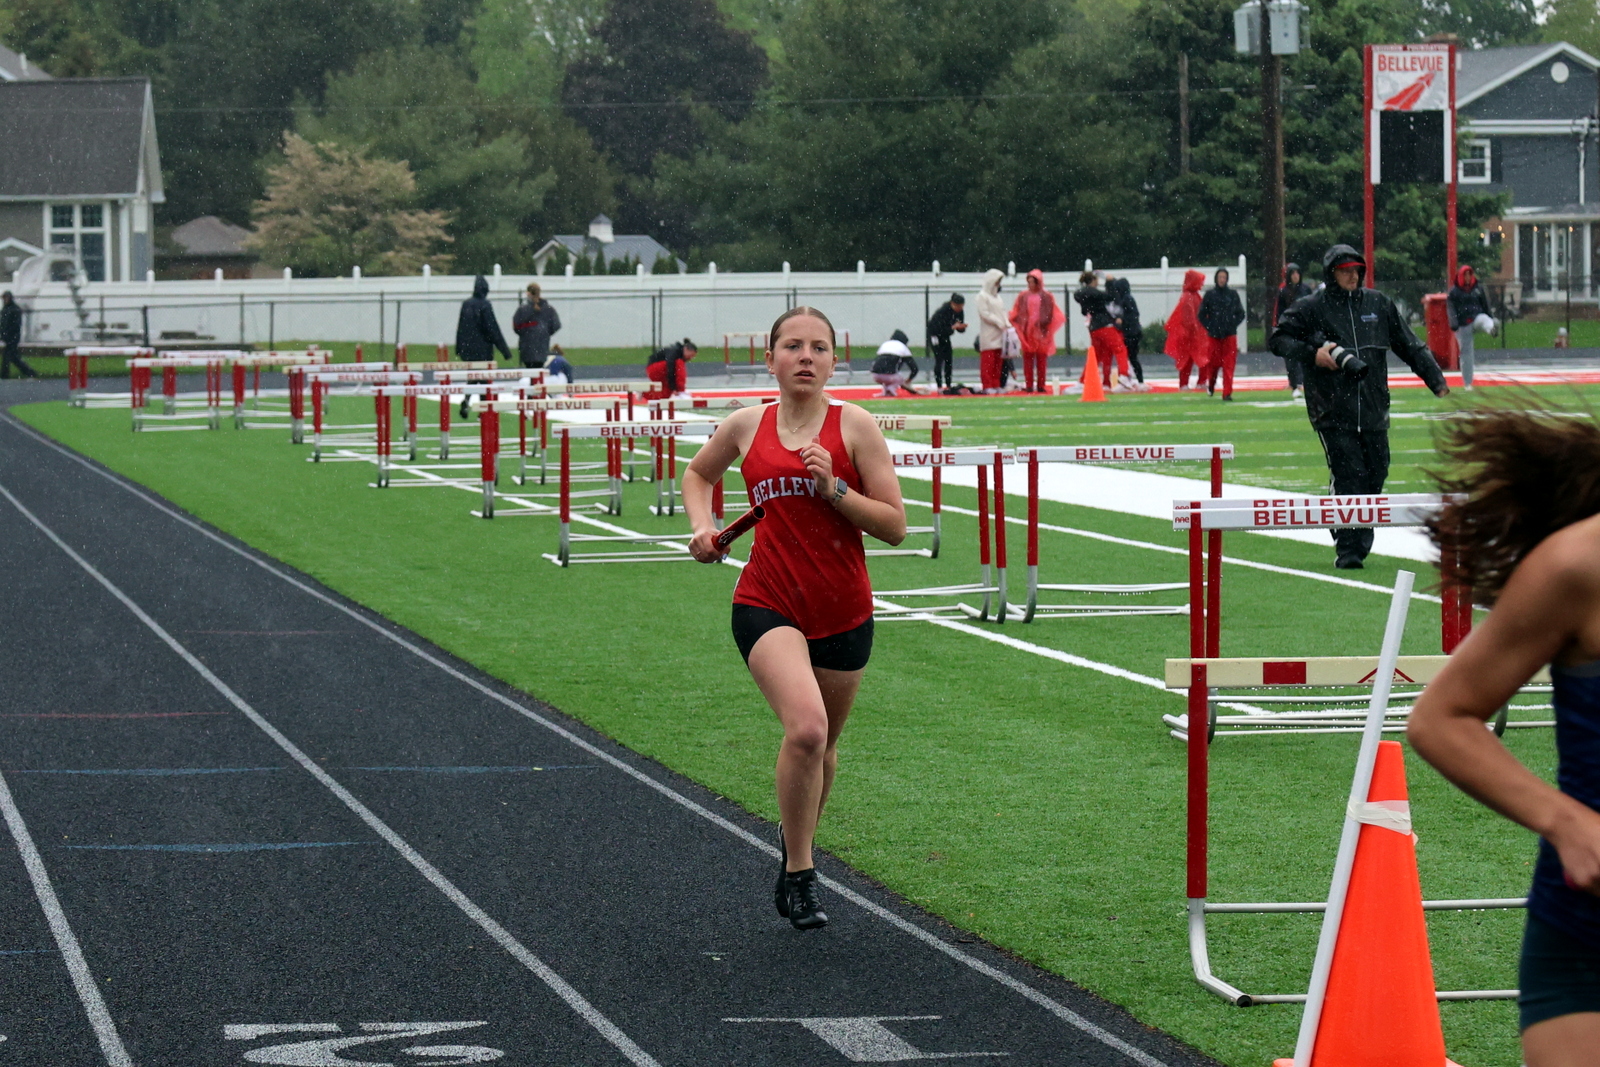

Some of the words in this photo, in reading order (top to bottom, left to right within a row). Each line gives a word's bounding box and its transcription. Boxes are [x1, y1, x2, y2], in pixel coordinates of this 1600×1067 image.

[1378, 54, 1443, 71] BELLEVUE
[338, 374, 389, 382] BELLEVUE
[405, 387, 463, 395] BELLEVUE
[566, 384, 630, 393] BELLEVUE
[516, 400, 591, 410] BELLEVUE
[600, 425, 683, 436] BELLEVUE
[892, 453, 956, 466] LEVUE
[1075, 447, 1175, 460] BELLEVUE
[752, 476, 816, 506] BELLEV
[1253, 508, 1391, 526] BELLEVUE
